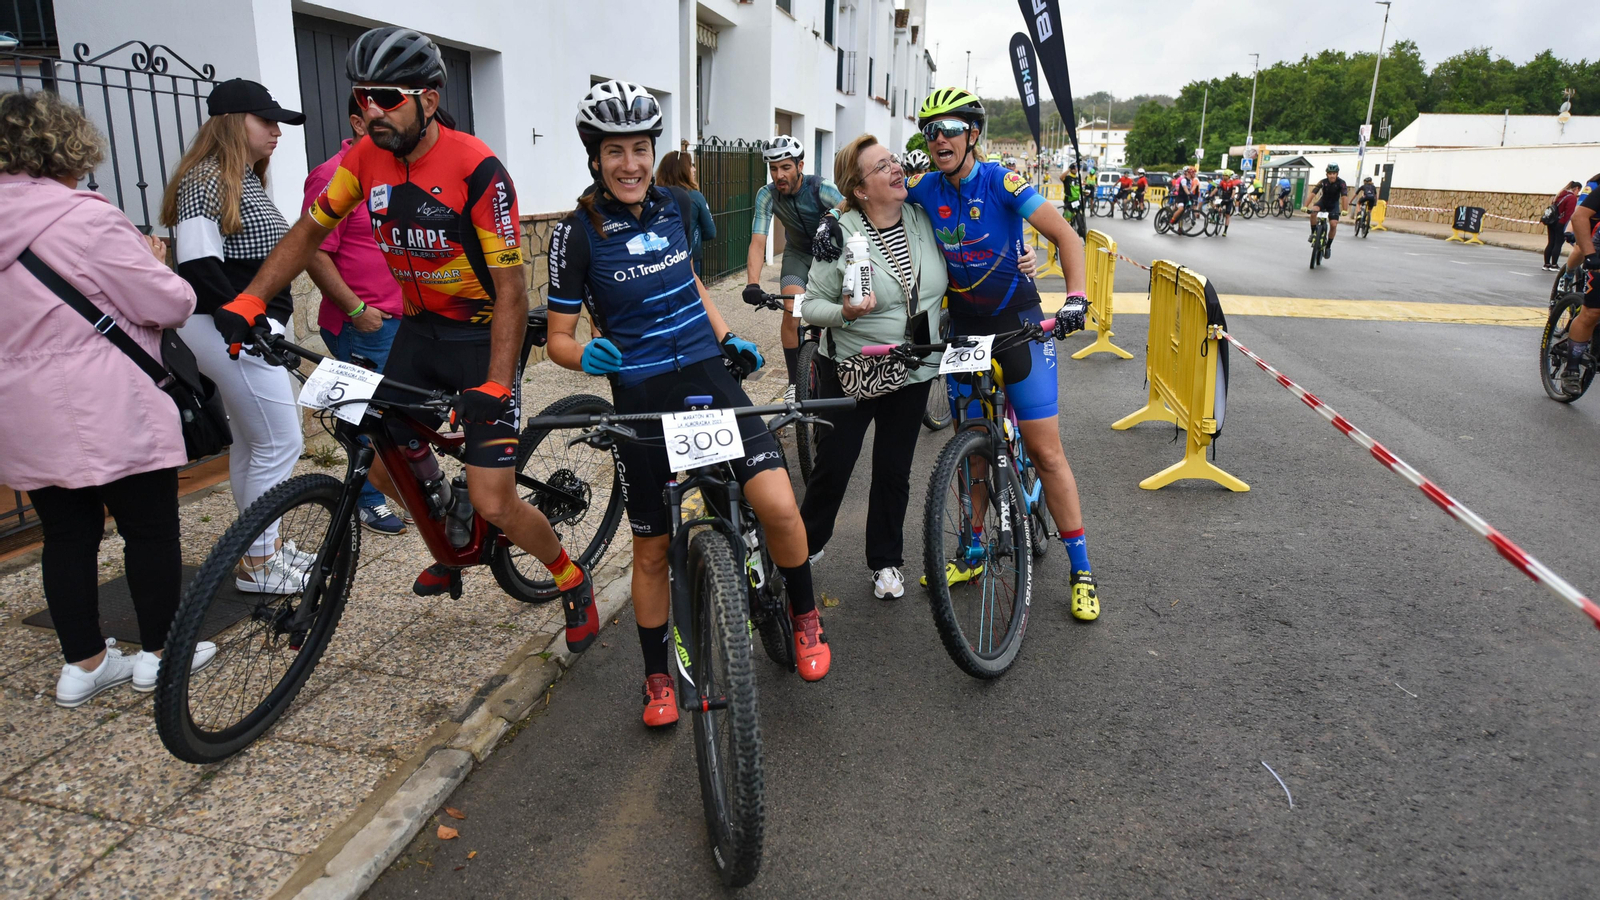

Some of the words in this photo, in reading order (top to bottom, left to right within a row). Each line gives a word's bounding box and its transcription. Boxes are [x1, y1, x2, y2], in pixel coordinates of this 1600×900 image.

[492, 197, 503, 239] CHICLANA
[495, 181, 516, 247] FALIBIKE
[560, 224, 572, 257] Parrado
[559, 260, 567, 269] by
[945, 345, 986, 365] 266
[326, 381, 349, 402] 5
[673, 428, 734, 456] 300
[1000, 501, 1010, 532] FOX
